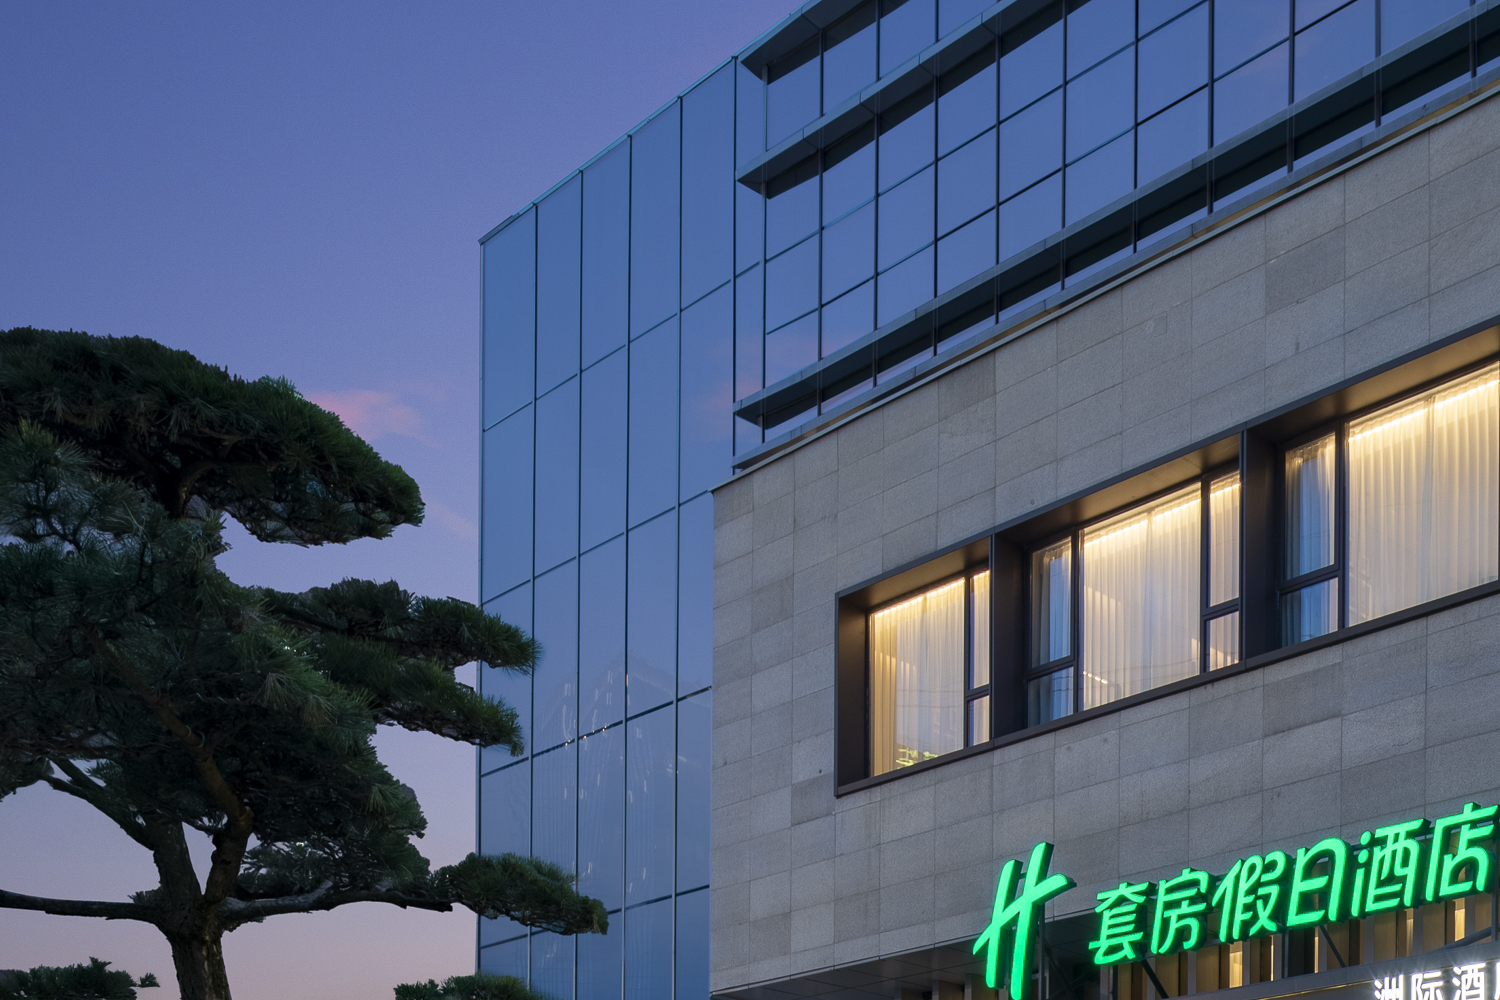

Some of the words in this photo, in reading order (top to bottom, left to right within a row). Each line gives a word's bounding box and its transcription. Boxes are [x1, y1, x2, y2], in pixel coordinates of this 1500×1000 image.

[1088, 802, 1499, 965] 套房假日酒店
